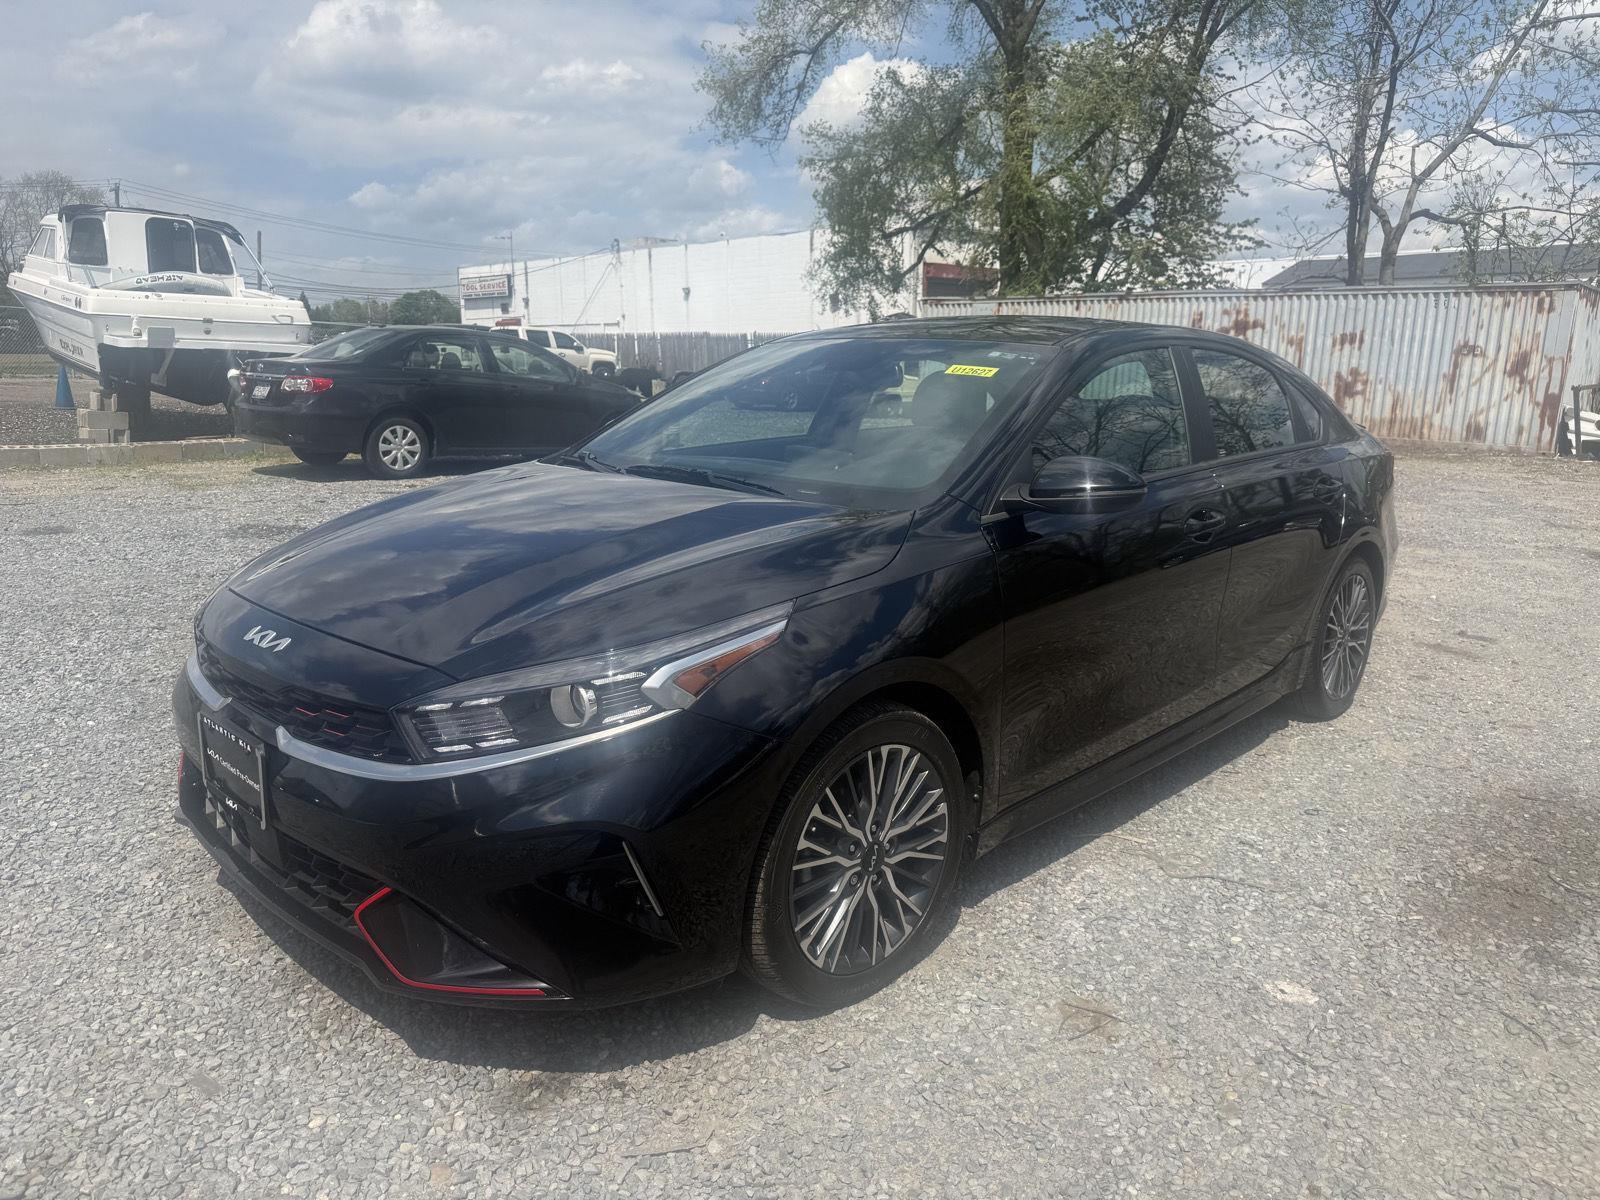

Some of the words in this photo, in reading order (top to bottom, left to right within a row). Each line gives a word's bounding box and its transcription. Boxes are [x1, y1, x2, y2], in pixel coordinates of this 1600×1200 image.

[462, 283, 478, 291] TOOL
[479, 280, 507, 290] SERVICE
[951, 366, 993, 376] U12627
[243, 625, 292, 653] KIA
[203, 717, 236, 741] ATLANTIC
[239, 739, 251, 752] KIA
[207, 748, 219, 761] KIA
[225, 797, 238, 811] KIA
